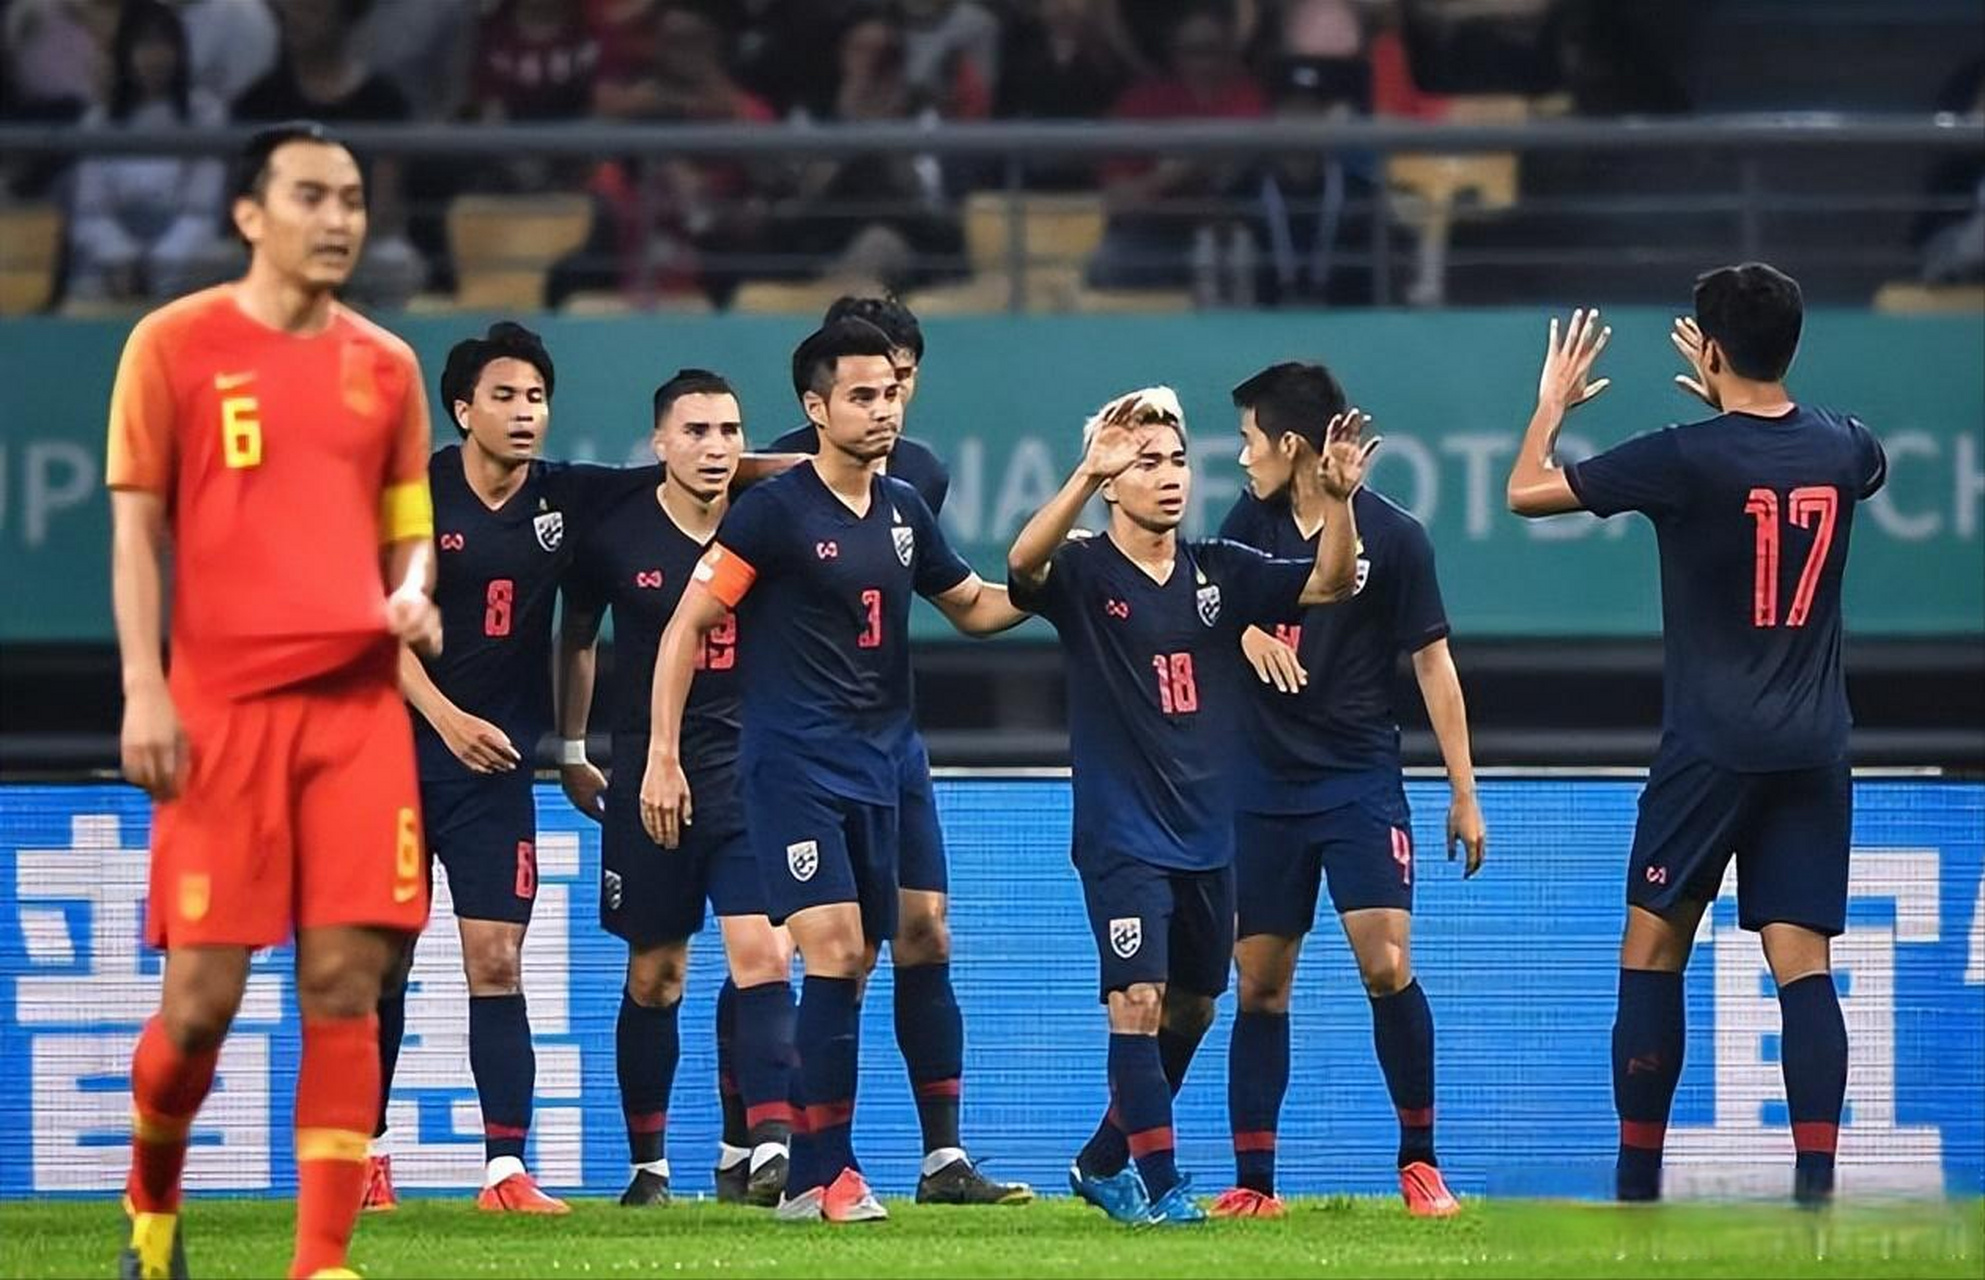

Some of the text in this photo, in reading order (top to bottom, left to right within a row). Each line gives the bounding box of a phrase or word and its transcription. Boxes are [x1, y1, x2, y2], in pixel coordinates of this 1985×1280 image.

[222, 397, 263, 469] 6
[0, 440, 98, 546] P
[1744, 485, 1839, 628] 17
[484, 579, 514, 637] 8
[857, 589, 883, 648] 3
[1152, 653, 1198, 714] 18
[396, 807, 421, 880] 6
[514, 840, 535, 899] 8
[1390, 826, 1411, 886] 4
